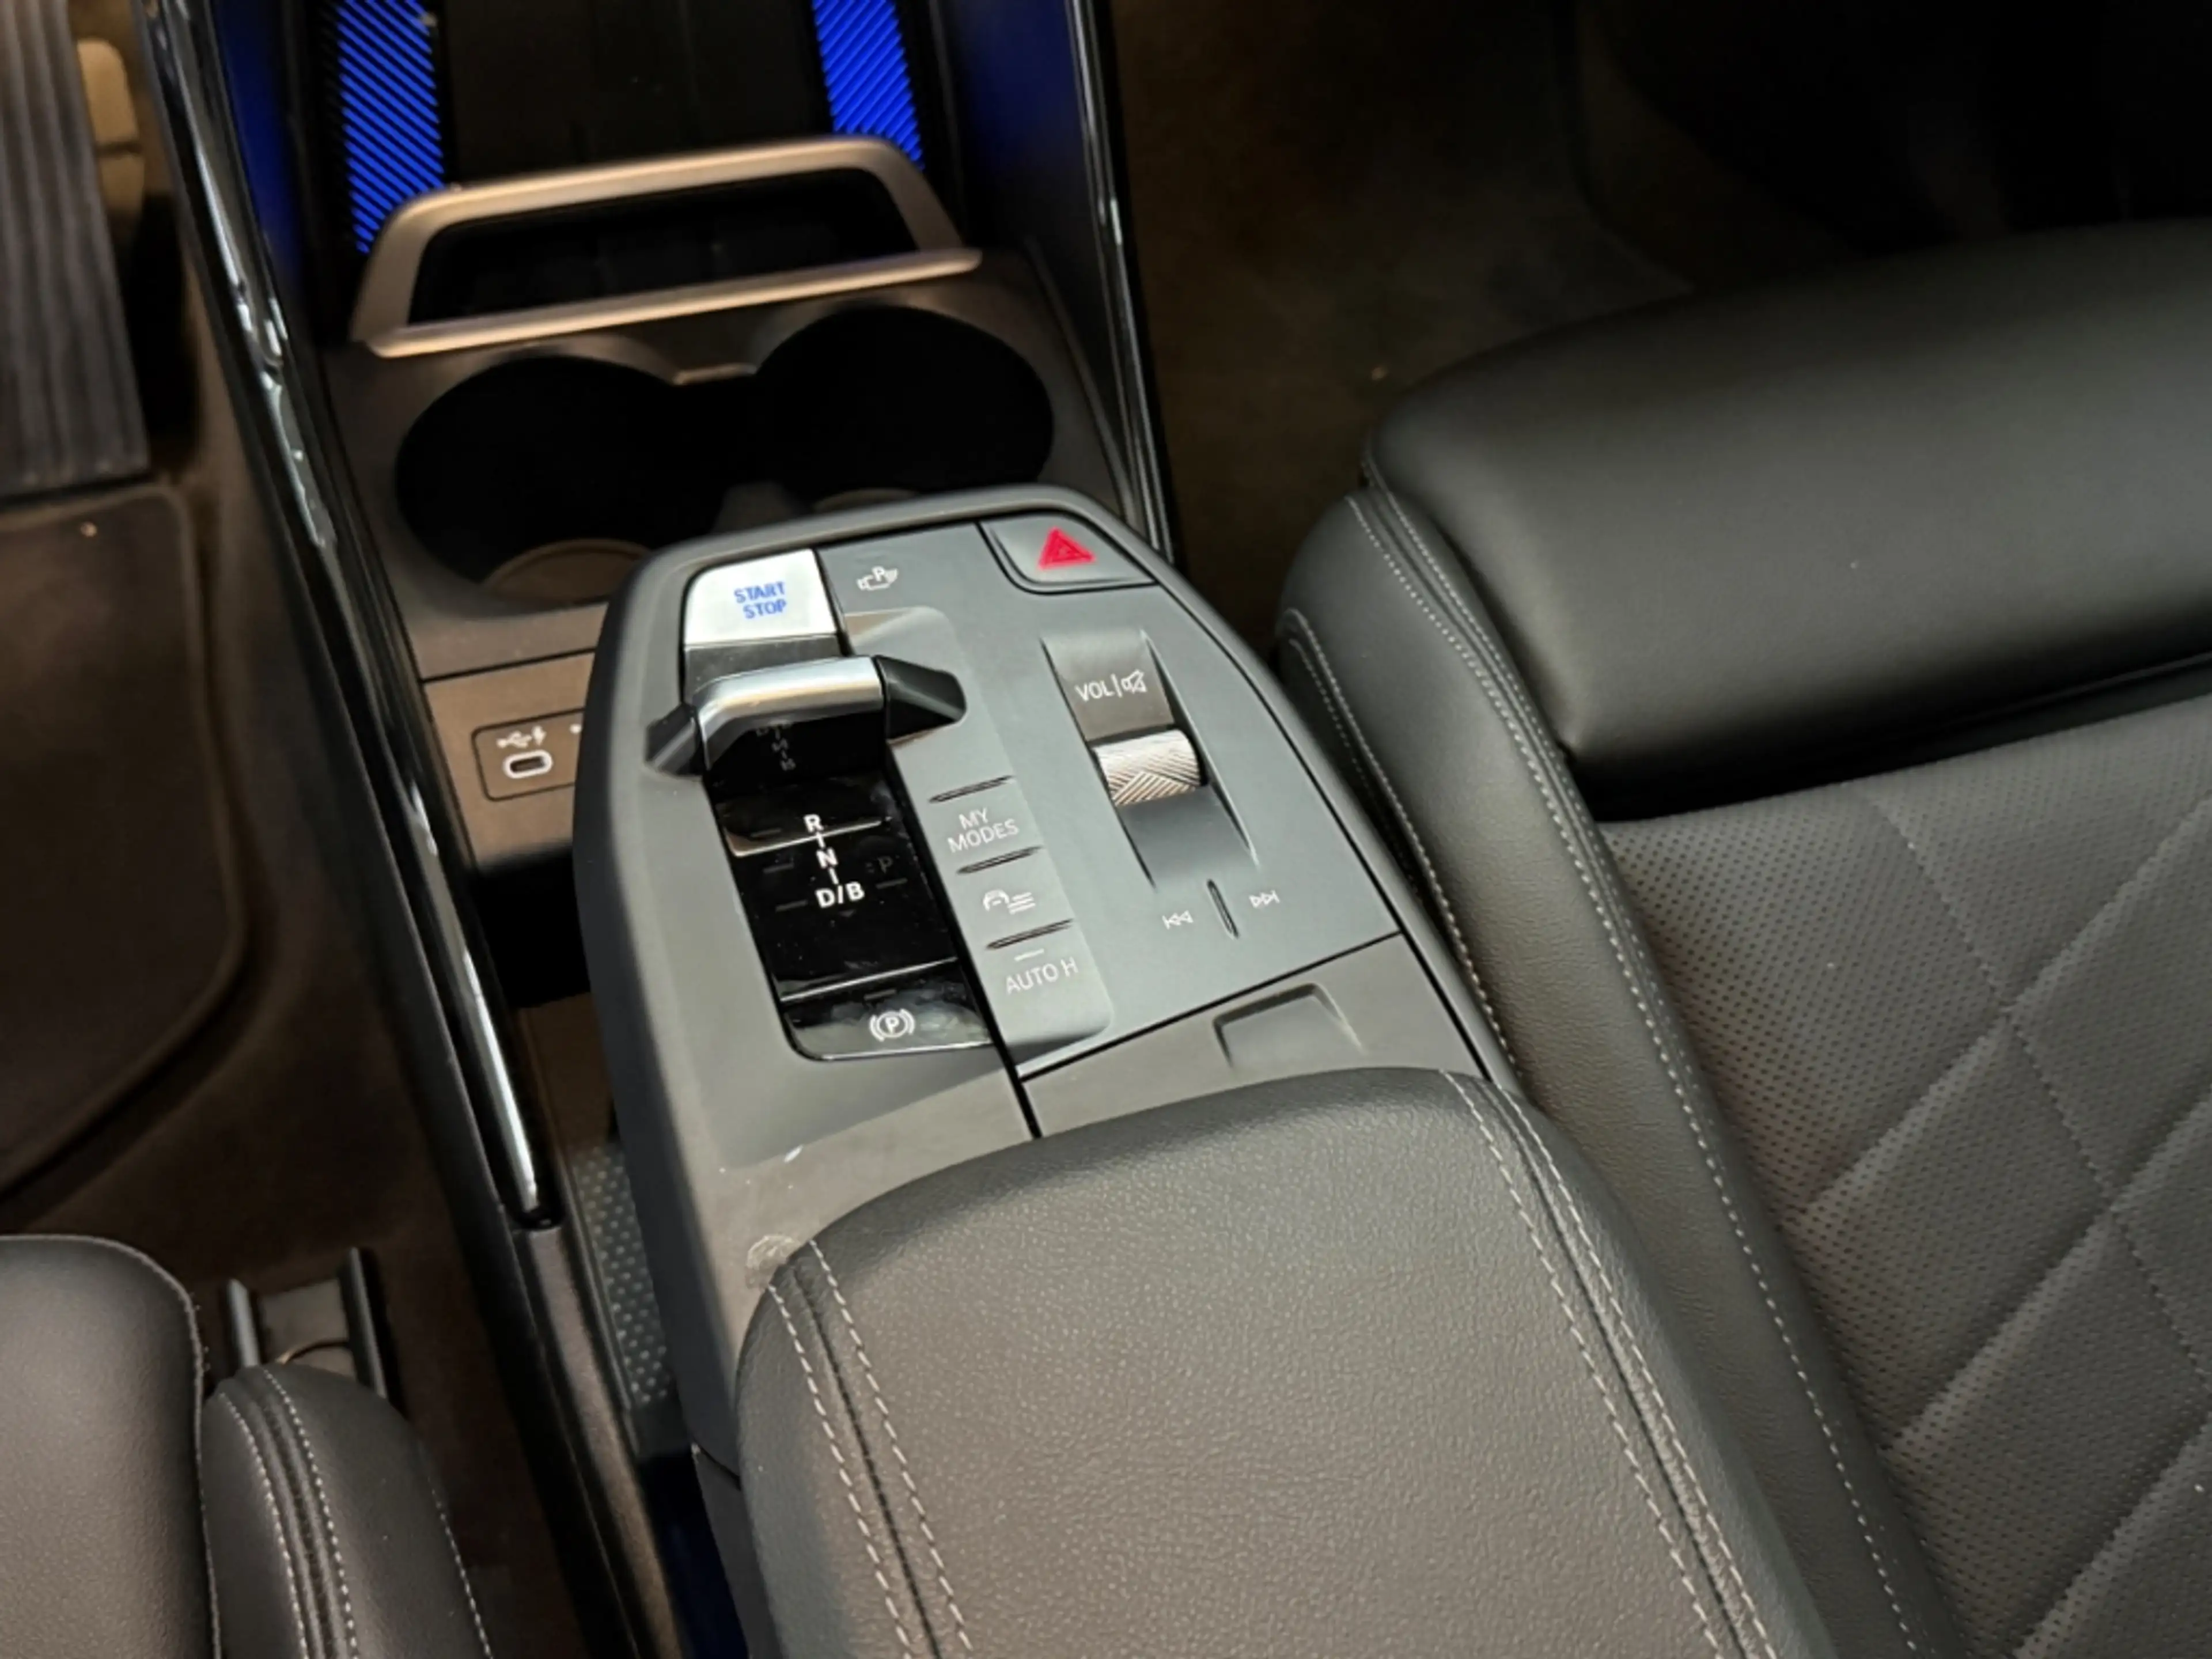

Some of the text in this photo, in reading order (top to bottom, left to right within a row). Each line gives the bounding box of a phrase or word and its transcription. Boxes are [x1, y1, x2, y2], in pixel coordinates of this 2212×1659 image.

[733, 580, 785, 603] START
[743, 598, 787, 619] STOP
[804, 813, 824, 833] R
[959, 807, 988, 830] MY
[948, 818, 1019, 853] MODES
[816, 846, 838, 869] N
[815, 881, 865, 908] D/B
[1006, 956, 1079, 995] AUTO H
